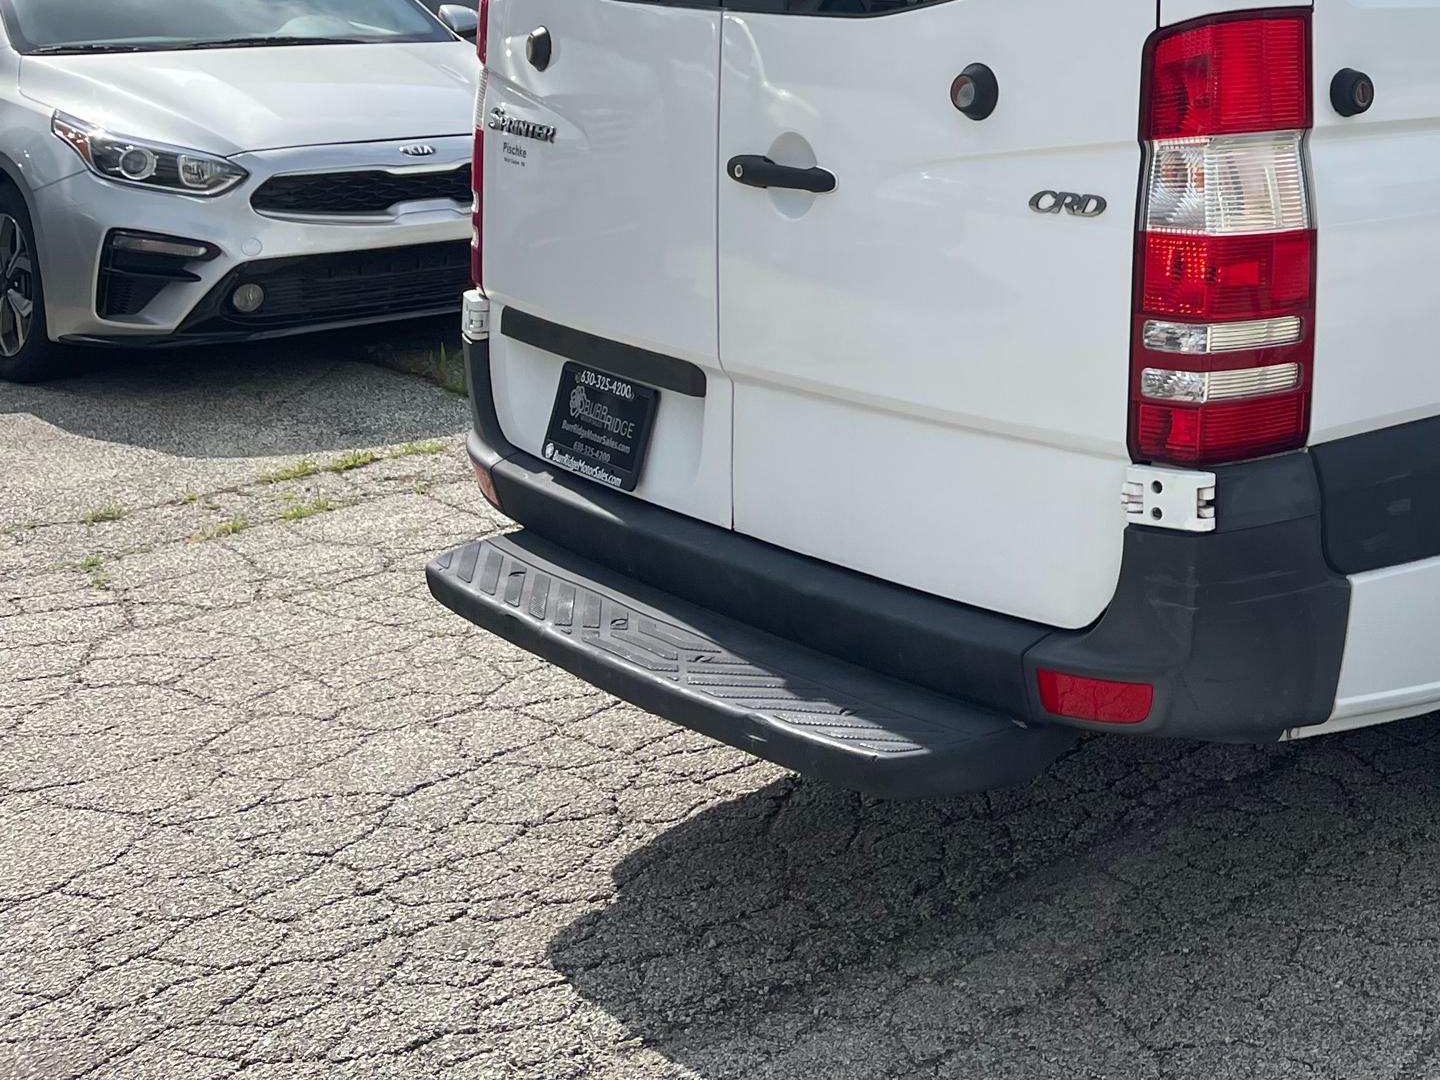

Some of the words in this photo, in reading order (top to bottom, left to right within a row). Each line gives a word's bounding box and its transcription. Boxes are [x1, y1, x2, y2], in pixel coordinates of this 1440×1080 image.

[406, 144, 433, 154] KIA
[1028, 189, 1107, 218] CRD
[580, 369, 632, 399] 630-325-4200
[604, 419, 635, 439] RIDGE
